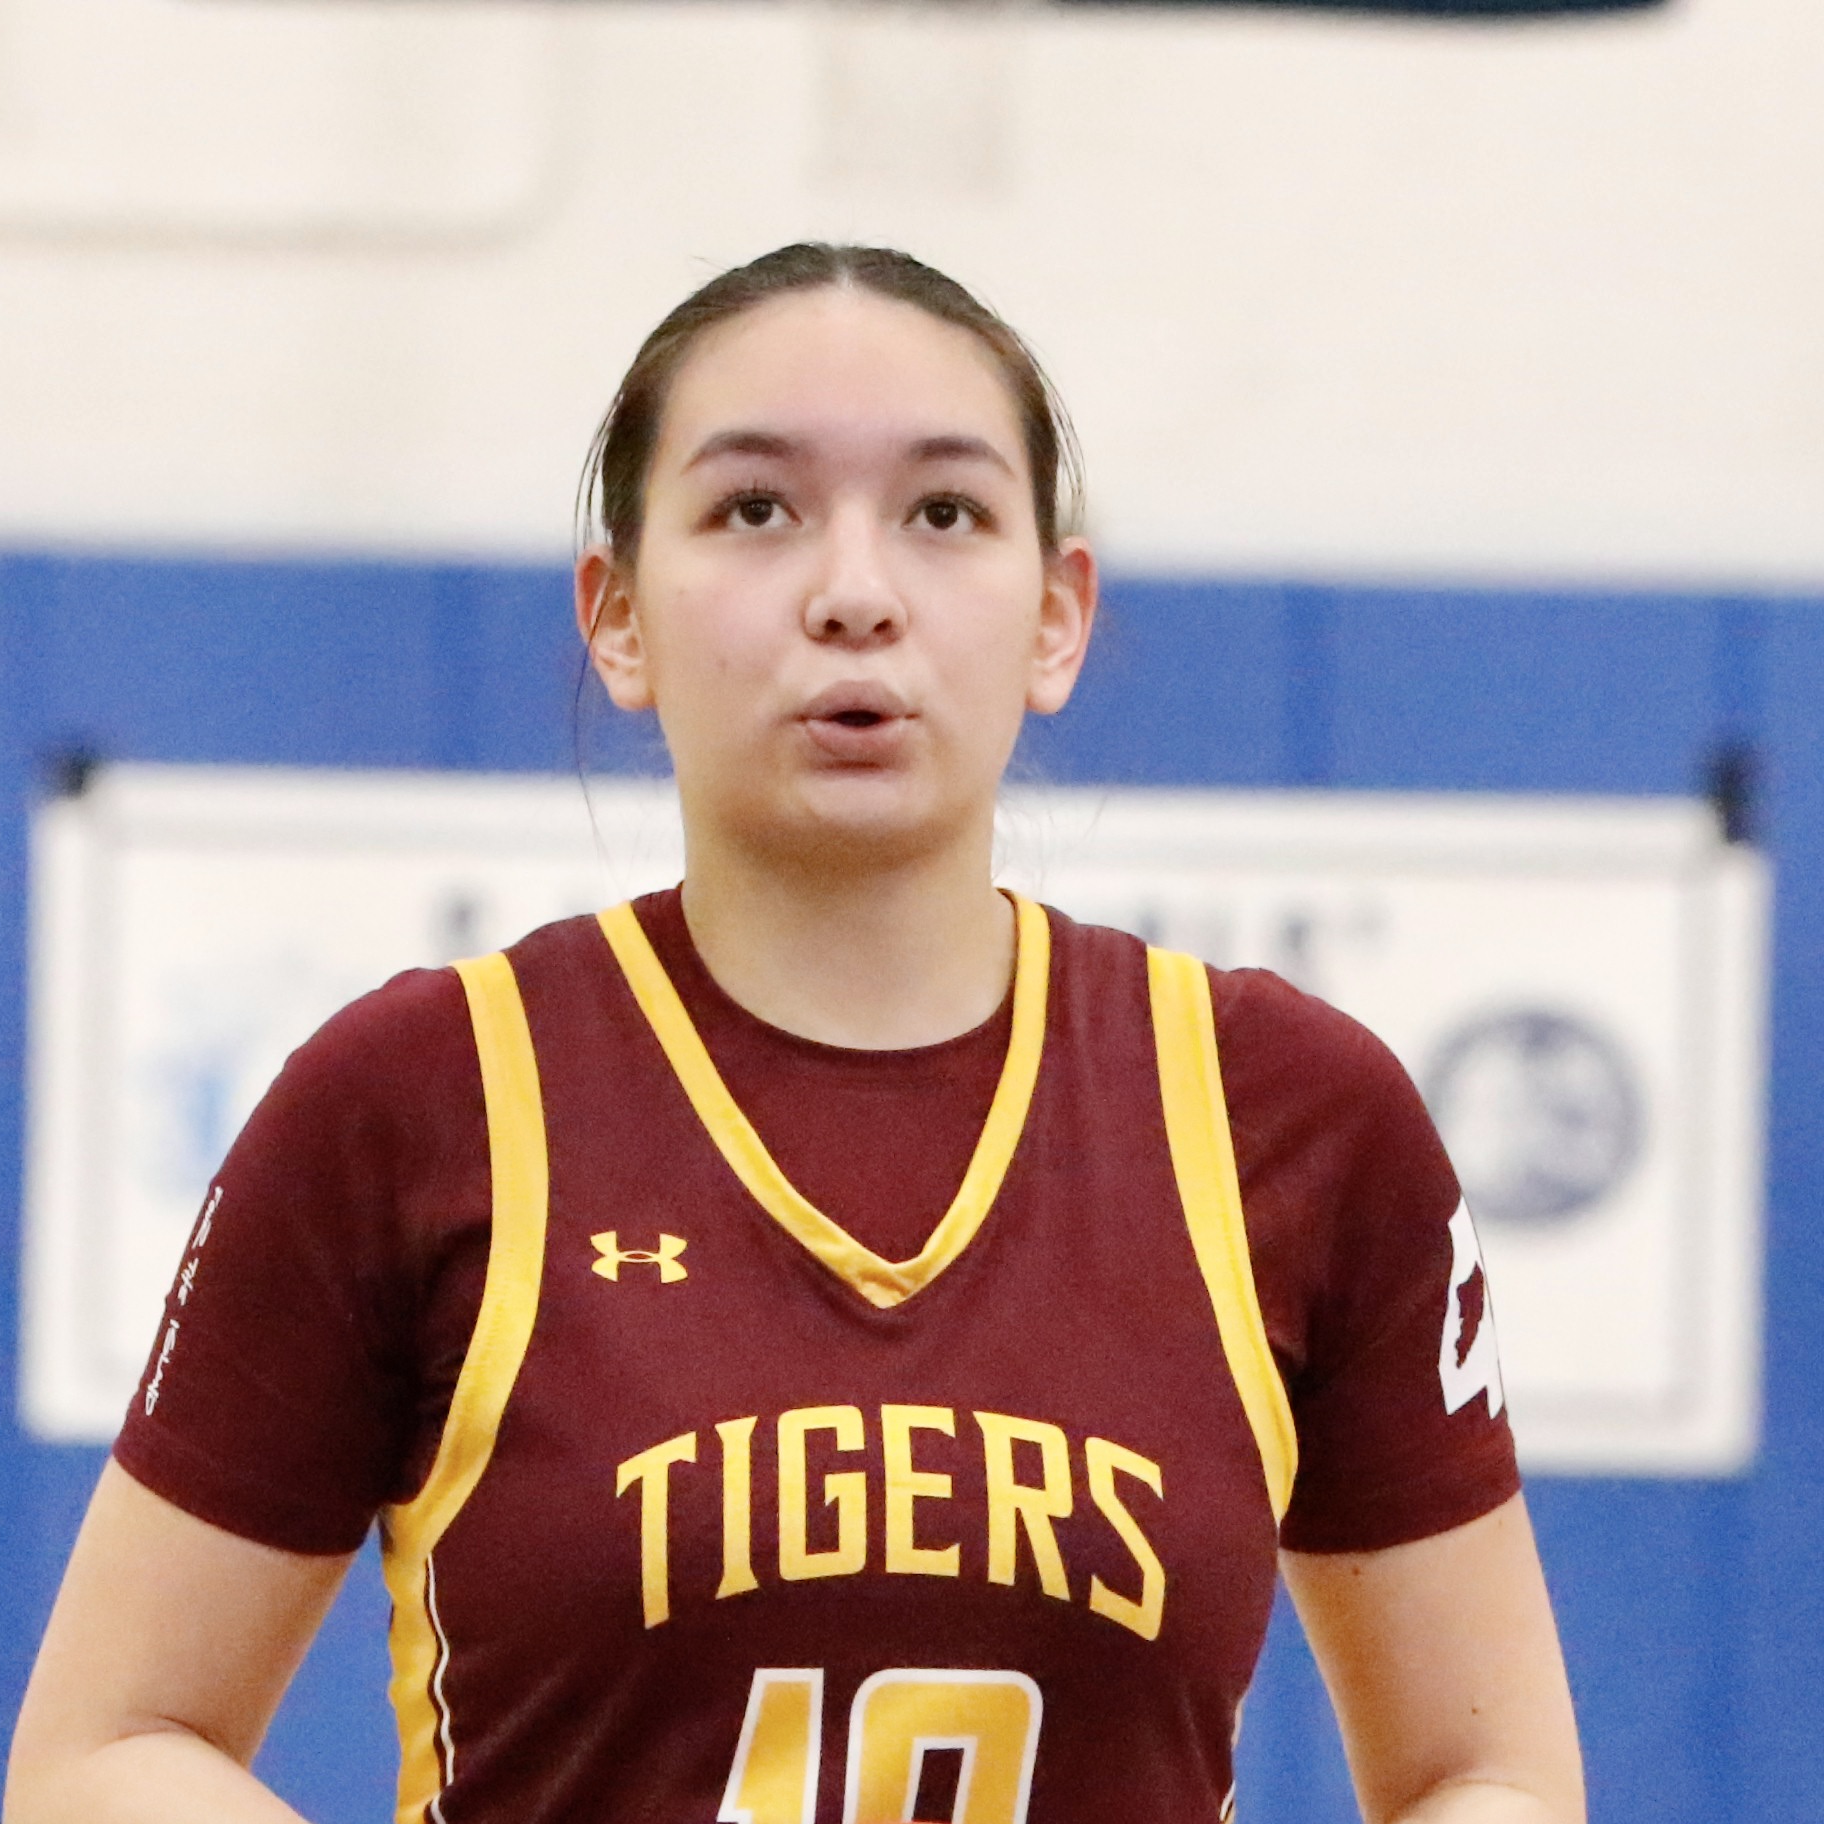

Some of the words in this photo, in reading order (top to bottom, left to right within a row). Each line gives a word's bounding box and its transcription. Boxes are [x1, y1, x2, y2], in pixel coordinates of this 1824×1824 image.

[191, 1185, 224, 1250] FOUR
[177, 1257, 199, 1306] THE
[145, 1318, 180, 1416] ISLAND
[615, 1403, 1166, 1642] TIGERS
